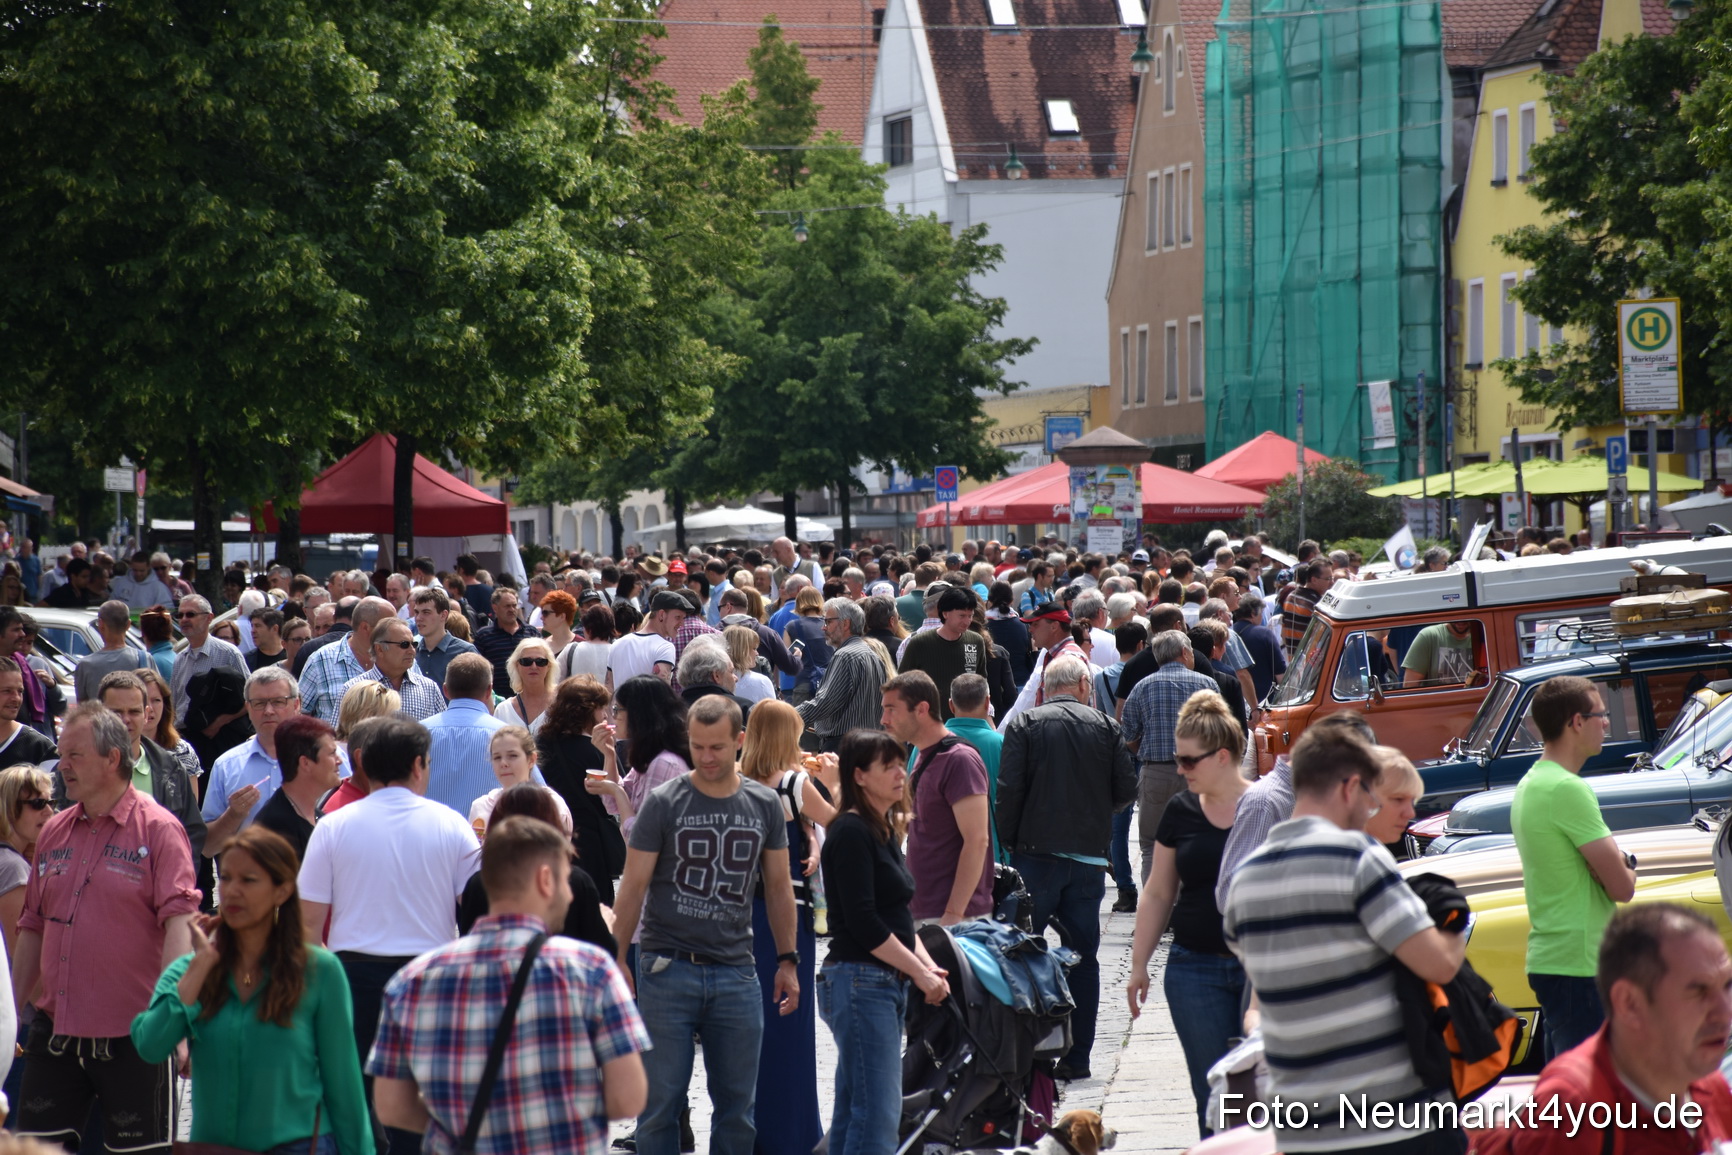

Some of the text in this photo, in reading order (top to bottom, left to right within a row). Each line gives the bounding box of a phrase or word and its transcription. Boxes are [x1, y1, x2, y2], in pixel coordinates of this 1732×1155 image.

[1639, 317, 1661, 342] H
[1630, 355, 1669, 363] Marktplatz
[1505, 402, 1546, 428] Restaurant
[1610, 441, 1622, 471] P
[938, 490, 956, 500] TAXI
[1173, 506, 1193, 514] Hotel
[1194, 506, 1233, 514] Restaurant
[964, 643, 977, 653] ICE
[676, 813, 729, 827] FIDELITY
[103, 844, 142, 865] TEAM
[673, 826, 763, 906] 89
[676, 904, 711, 920] BOSTON
